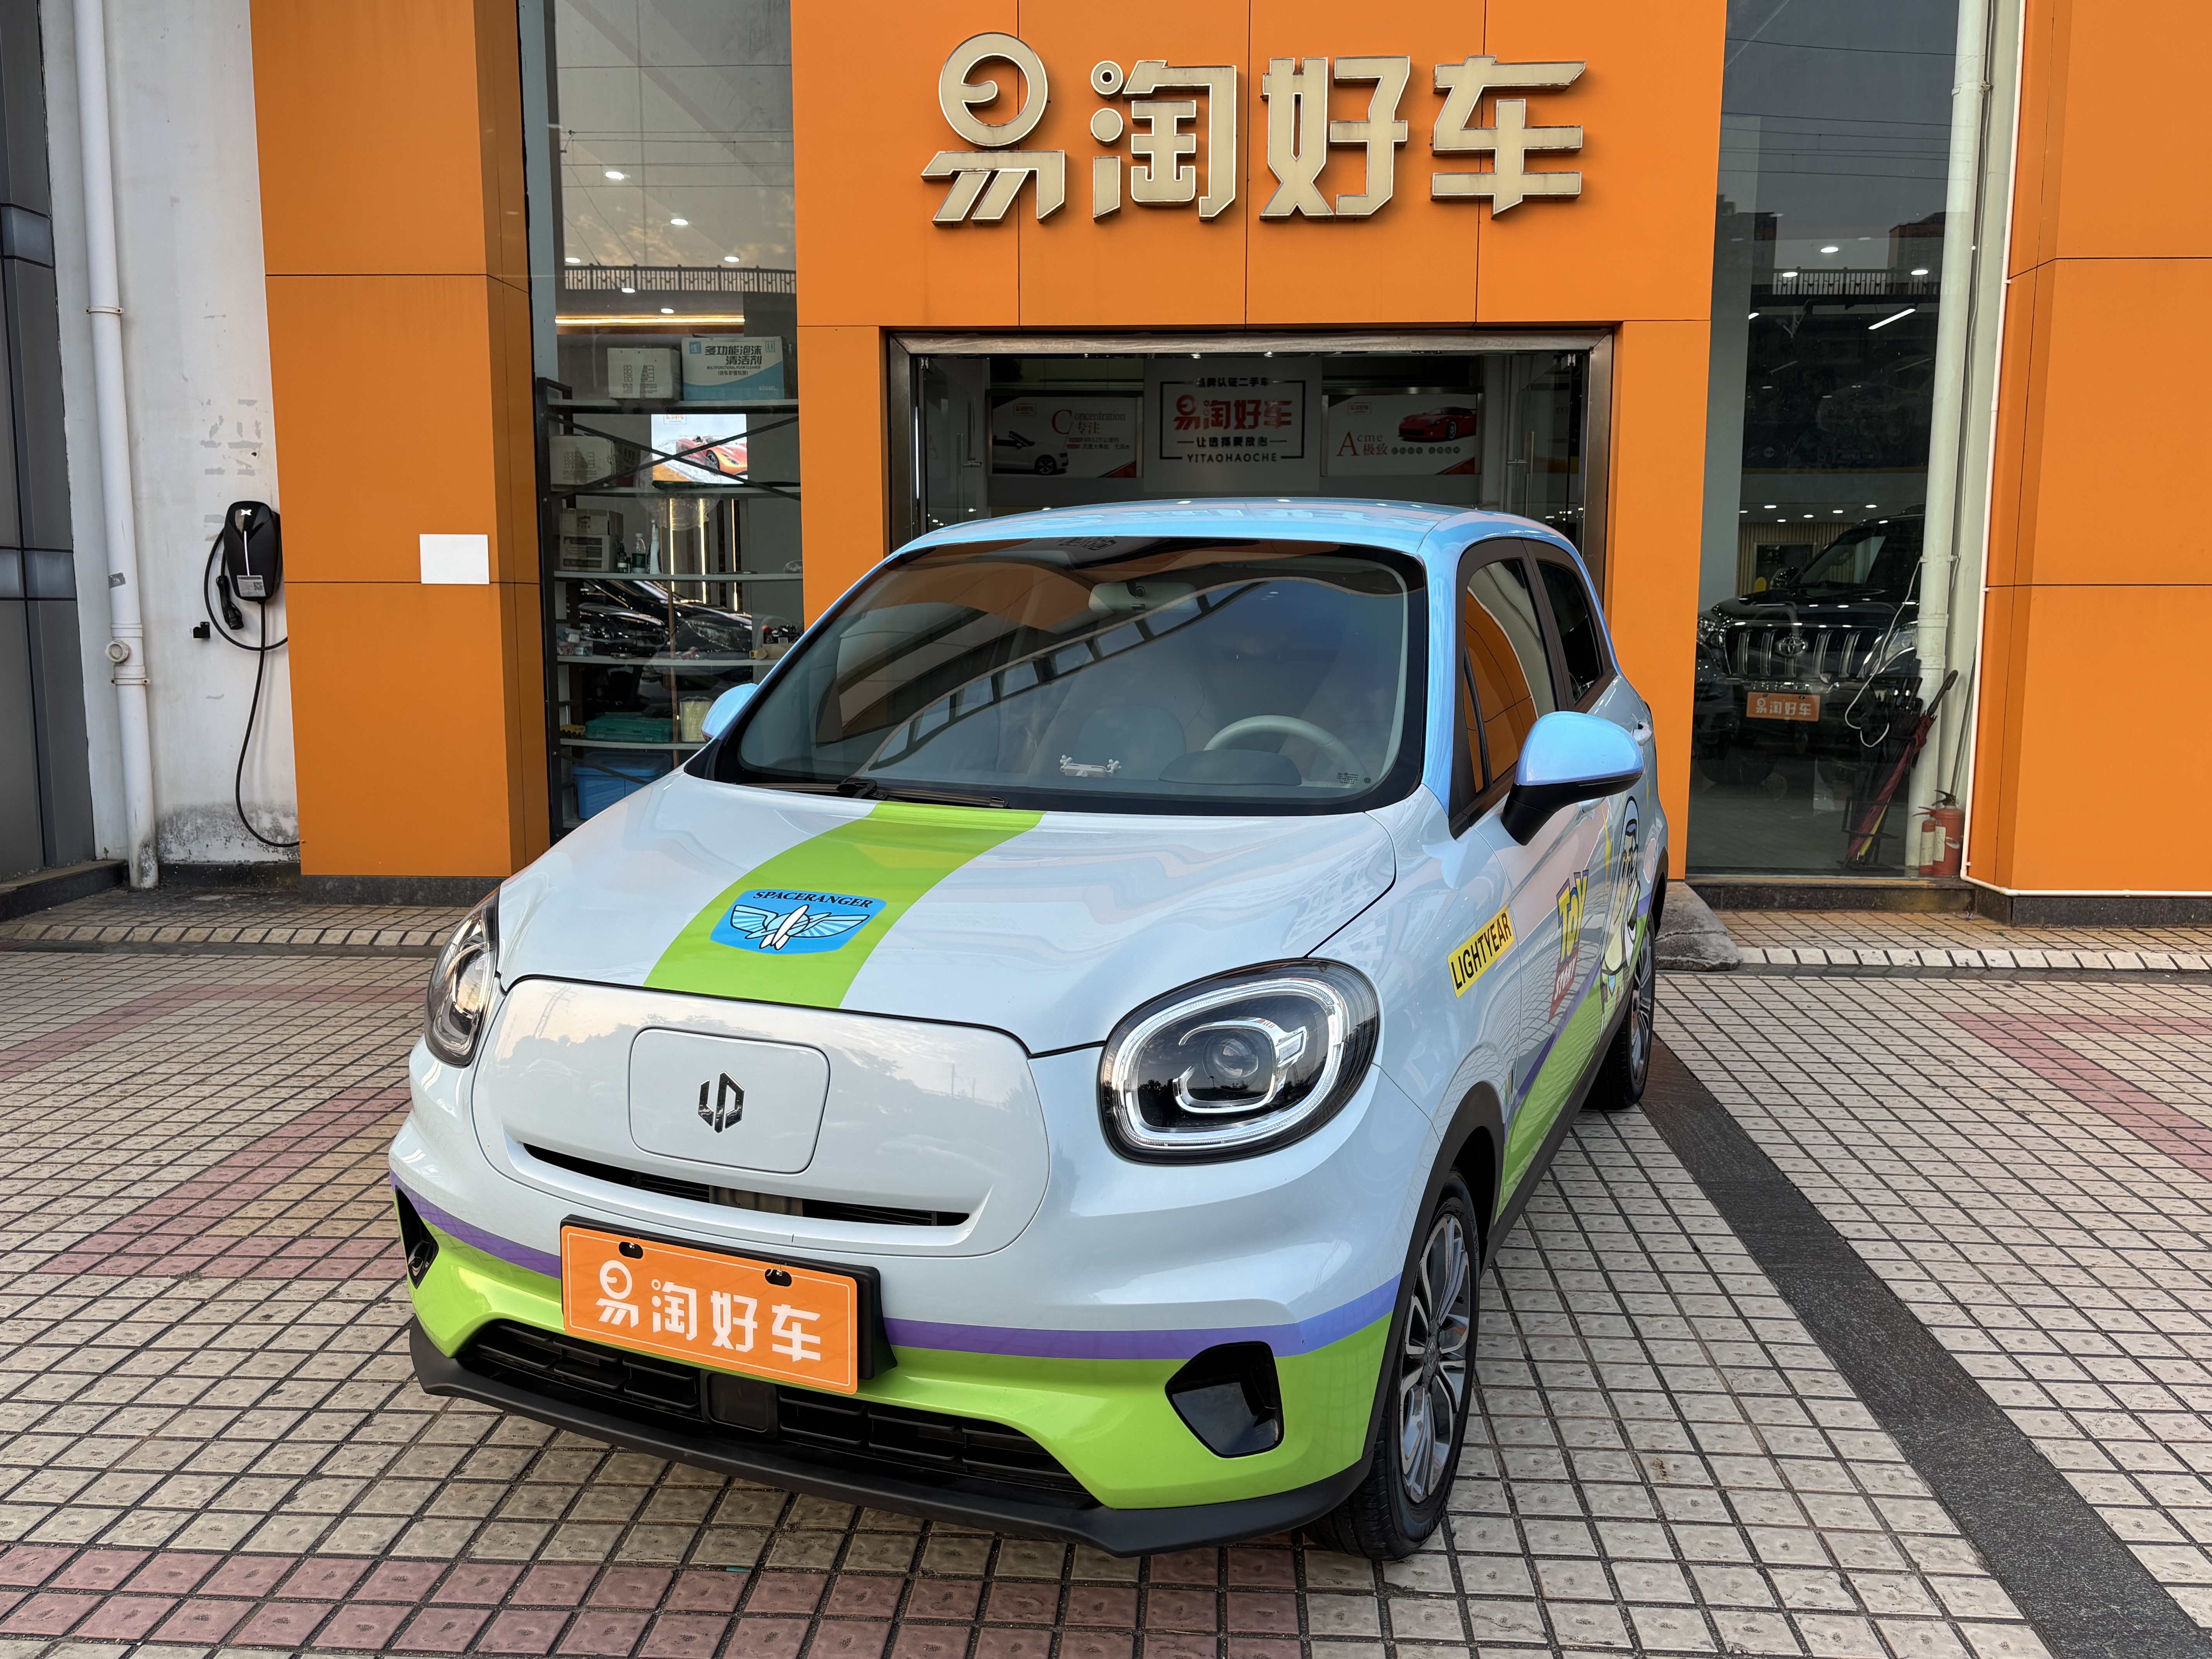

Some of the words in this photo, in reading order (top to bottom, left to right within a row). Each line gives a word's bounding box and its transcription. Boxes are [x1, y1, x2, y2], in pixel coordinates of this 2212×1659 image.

[920, 32, 1587, 224] 易淘好车
[705, 345, 762, 356] 多功能泡沫
[725, 356, 762, 365] 清洁剂
[1195, 377, 1269, 388] 品牌认证二手车
[1173, 394, 1292, 431] 易淘好车
[1077, 422, 1101, 434] 专注
[1196, 436, 1267, 447] 让选择更放心
[1335, 431, 1383, 456] Acme
[1363, 443, 1388, 455] 极致
[1187, 453, 1277, 463] YITAOHAOCHE
[1756, 698, 1811, 716] 易淘好车
[753, 891, 873, 908] SPACERANGER
[1451, 912, 1512, 990] LIGHTYEAR
[1554, 956, 1577, 1001] STORY
[594, 1259, 822, 1363] 易淘好车
